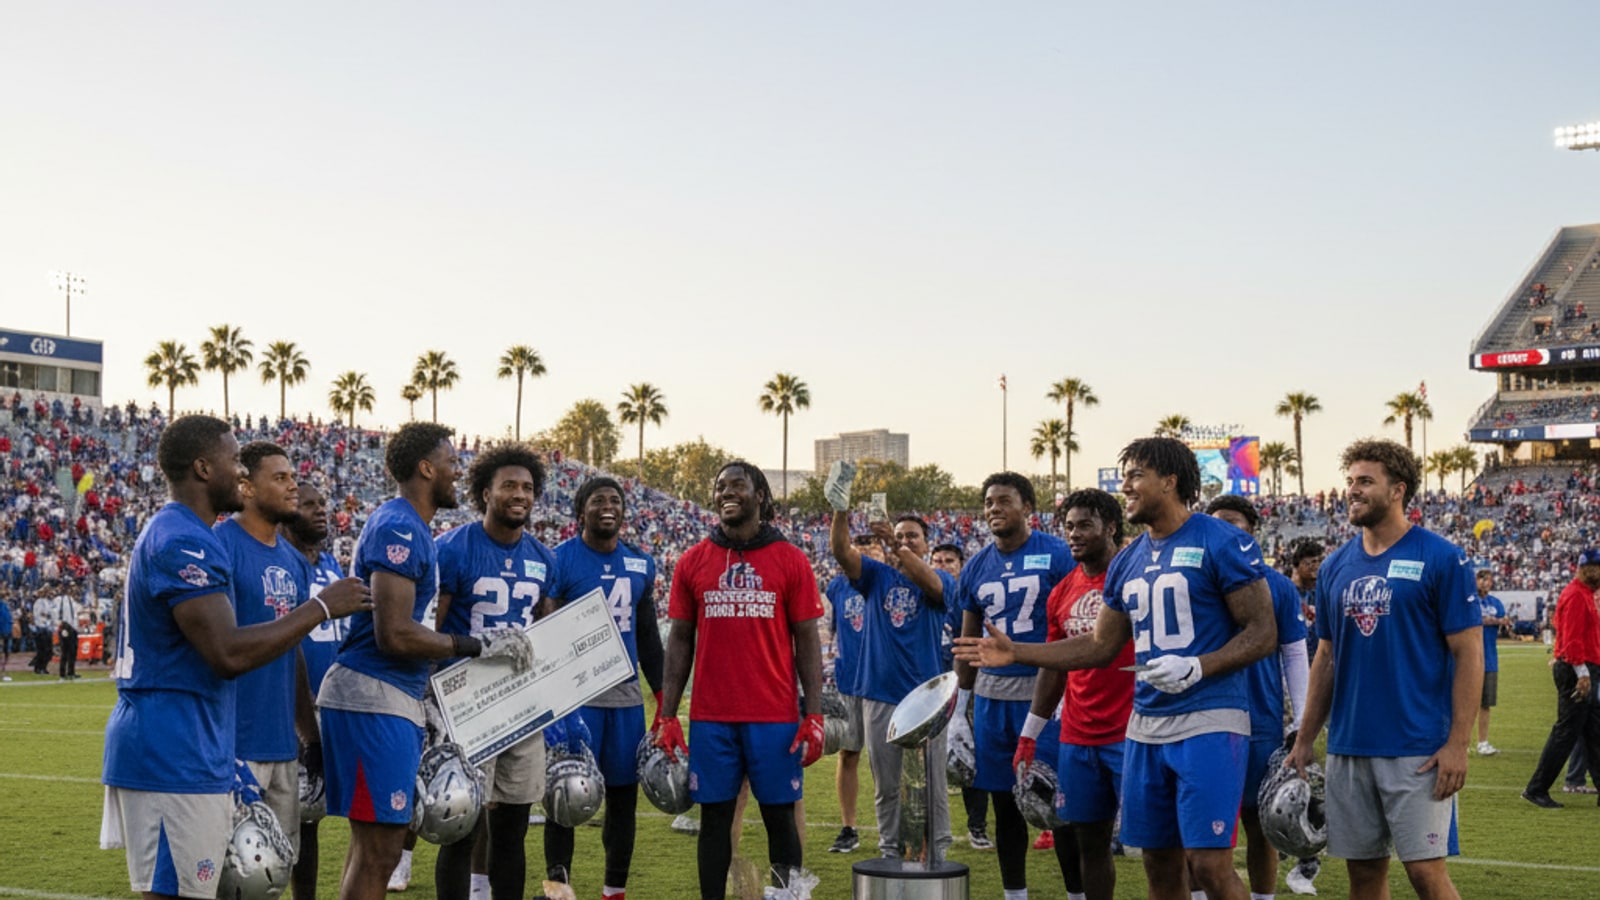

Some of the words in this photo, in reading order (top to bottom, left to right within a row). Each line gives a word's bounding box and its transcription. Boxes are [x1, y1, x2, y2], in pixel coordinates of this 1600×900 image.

[470, 576, 540, 635] 23
[977, 574, 1040, 639] 27
[1122, 571, 1195, 653] 20
